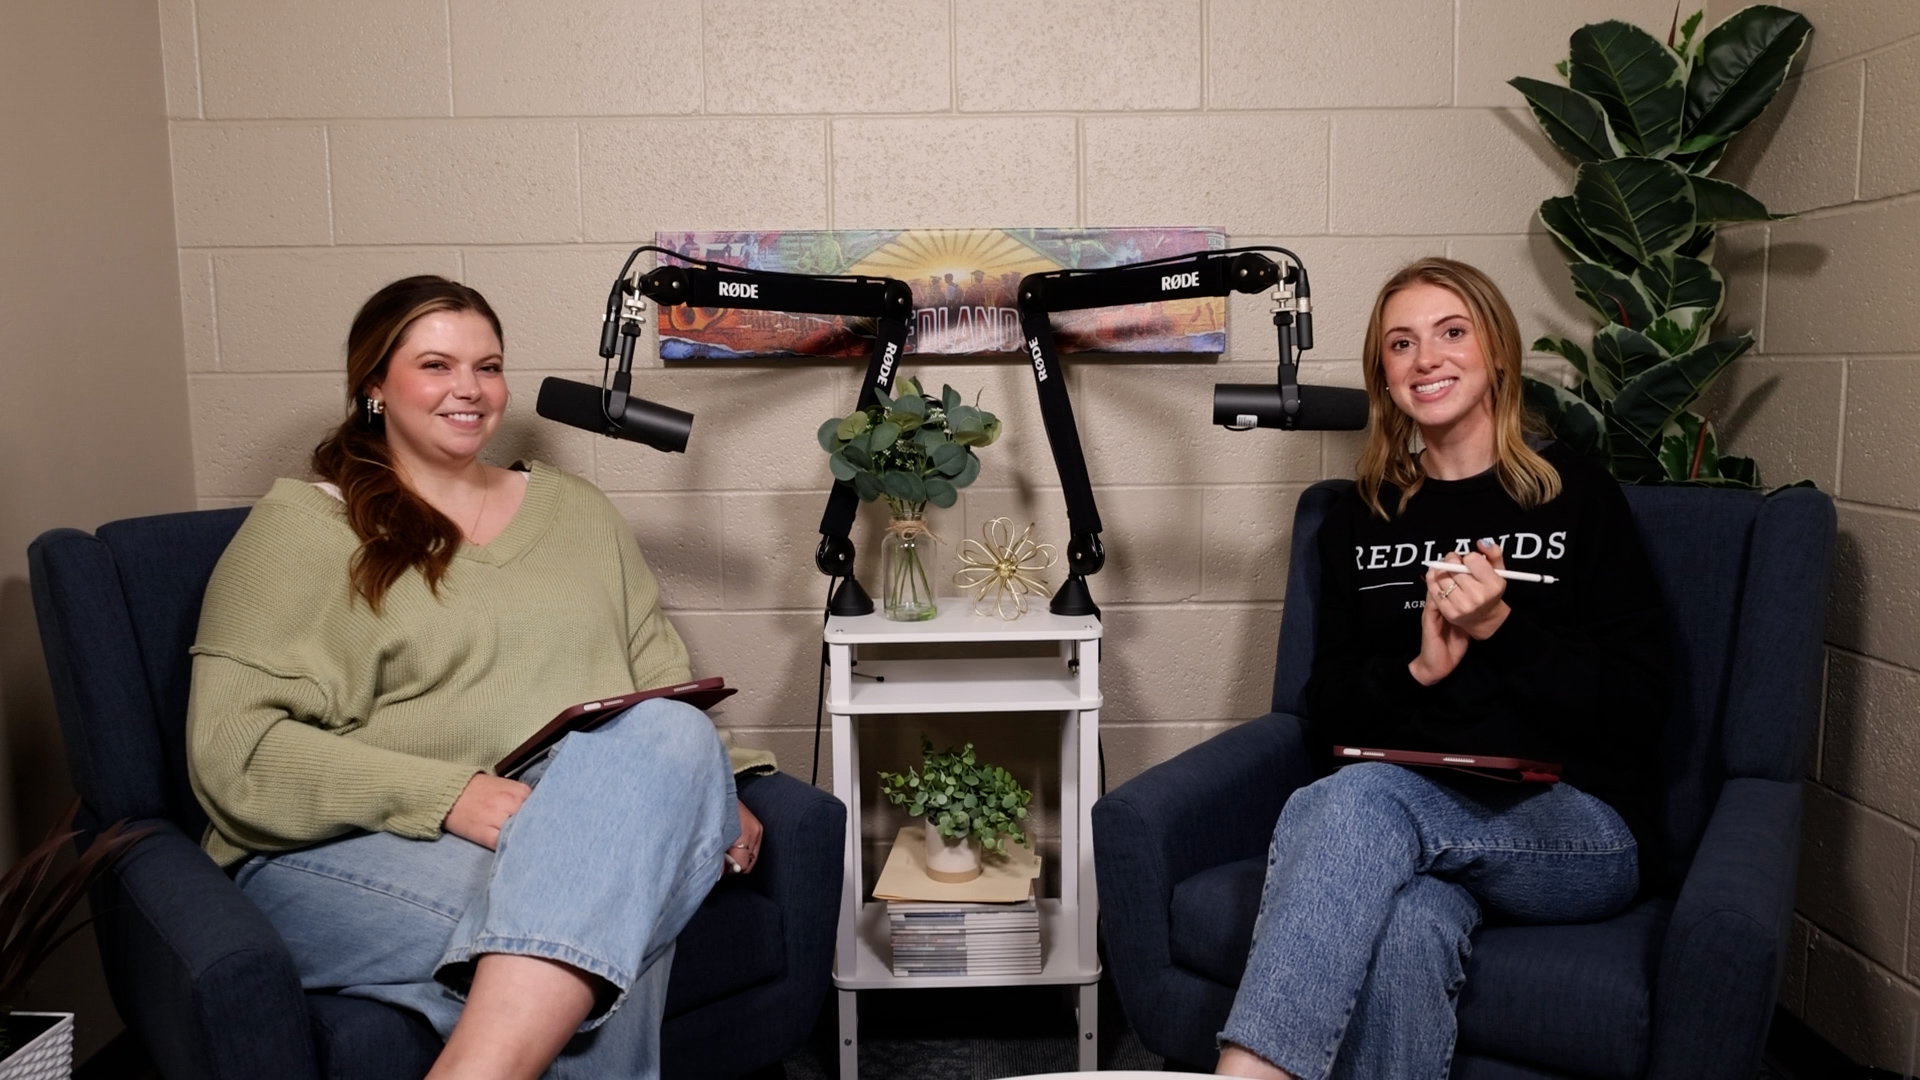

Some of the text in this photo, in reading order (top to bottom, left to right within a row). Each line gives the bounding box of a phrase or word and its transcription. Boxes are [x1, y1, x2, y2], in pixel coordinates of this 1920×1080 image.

[718, 281, 759, 299] RØDE
[1161, 271, 1200, 291] RØDE
[902, 306, 1029, 354] EDLAND
[876, 341, 898, 387] RØDE
[1028, 336, 1048, 382] RØDE
[1403, 600, 1426, 610] AGR
